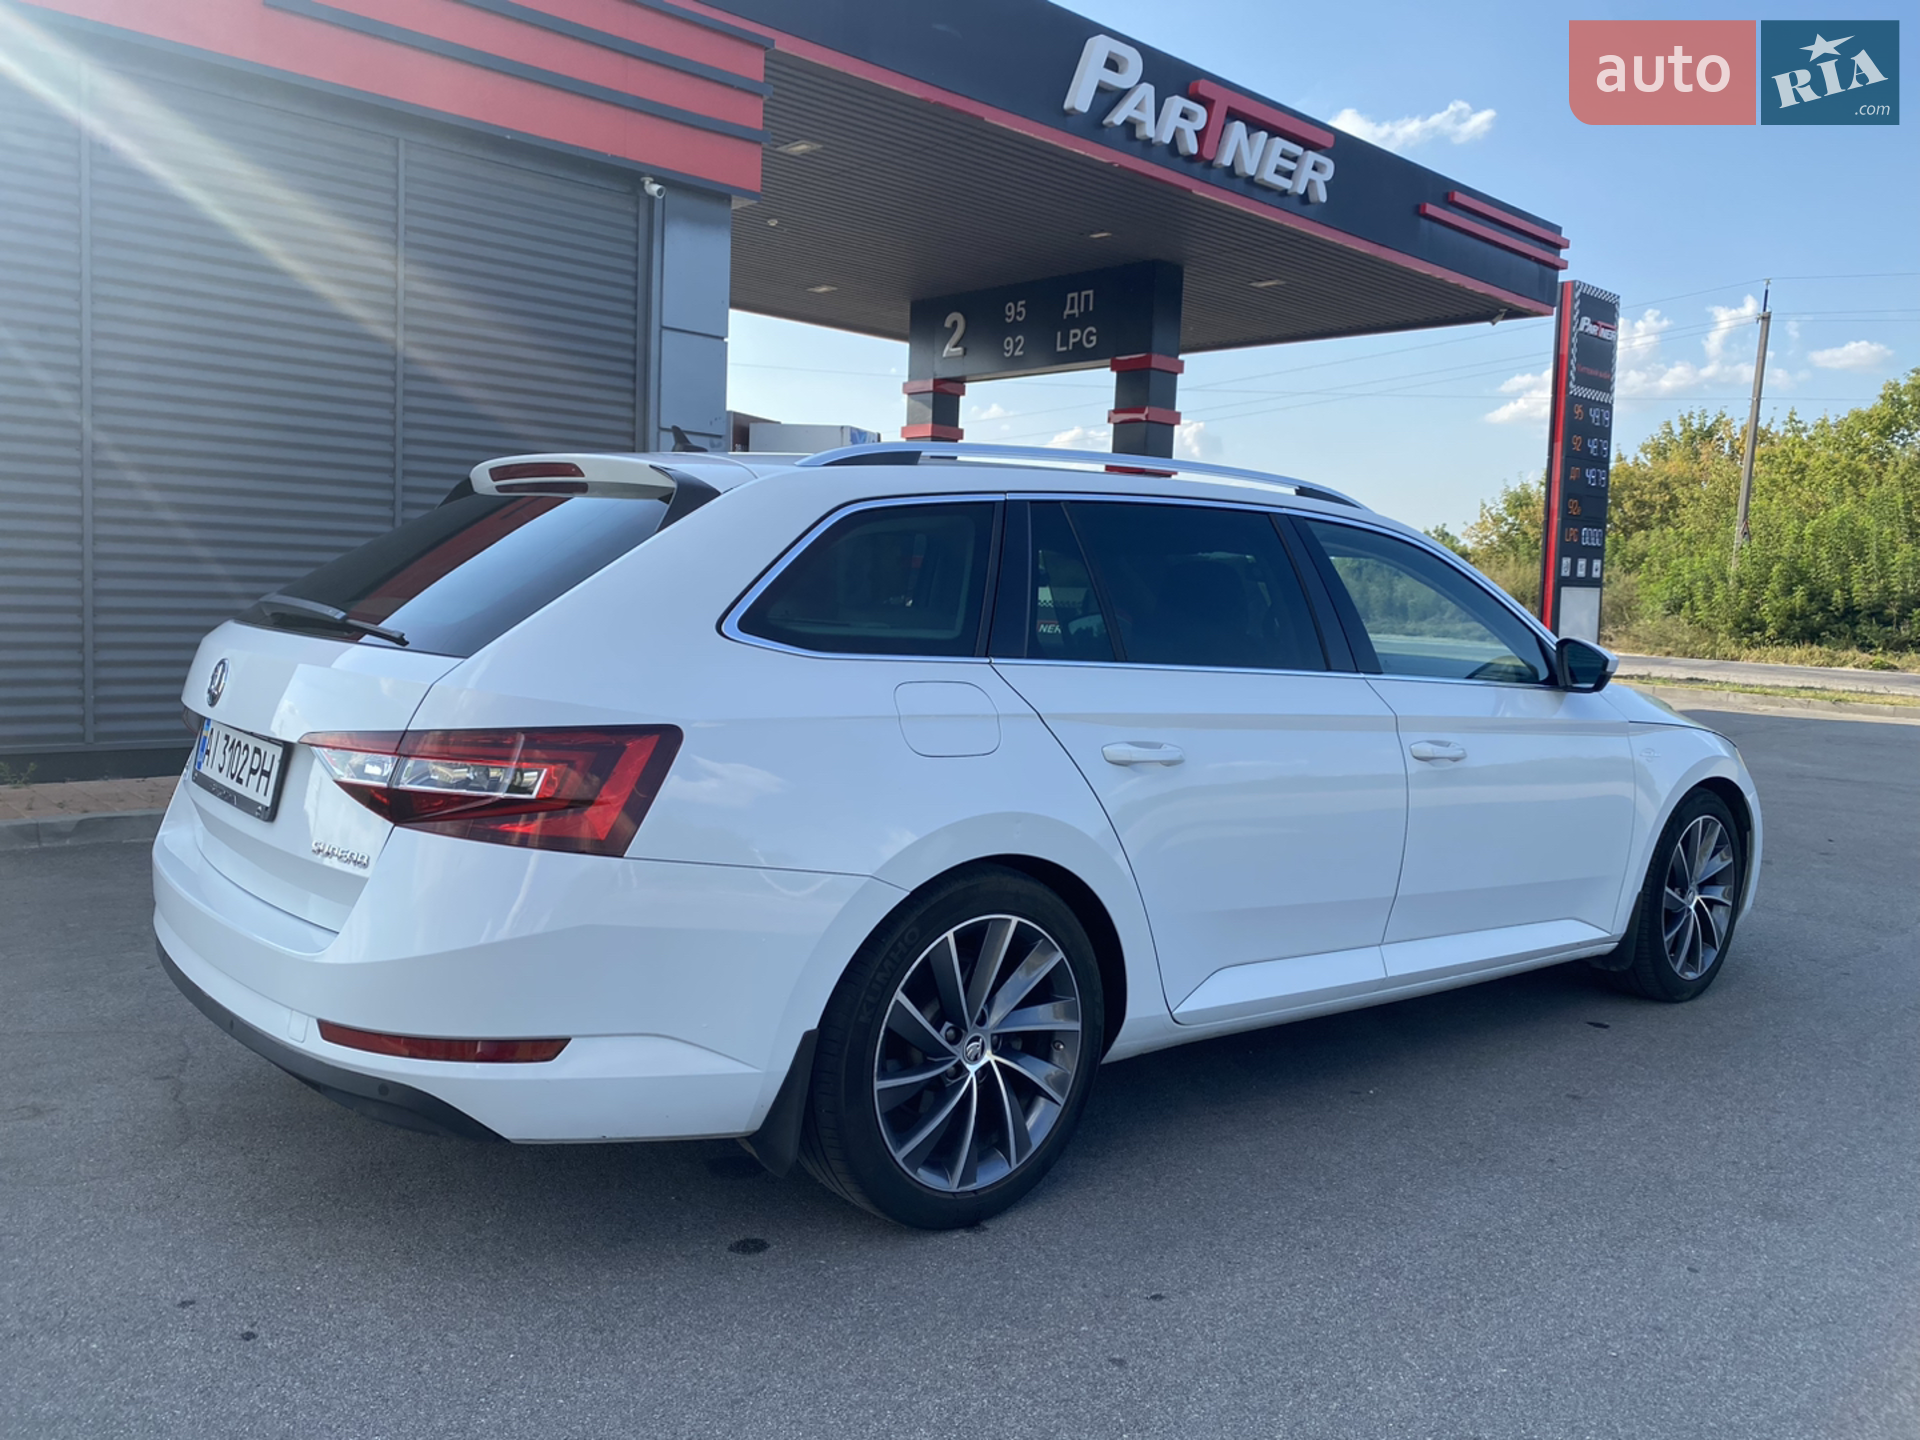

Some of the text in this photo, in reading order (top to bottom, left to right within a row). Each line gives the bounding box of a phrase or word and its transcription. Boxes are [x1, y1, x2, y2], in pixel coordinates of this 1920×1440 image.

[1063, 34, 1335, 203] PARTNER
[1004, 289, 1094, 323] 95 ДП
[942, 311, 967, 358] 2
[1003, 326, 1097, 357] 92 LPG
[1574, 403, 1584, 420] 95
[1572, 435, 1582, 451] 92
[218, 734, 250, 785] 3102
[245, 746, 276, 797] PH
[858, 926, 921, 1024] KUMHO
